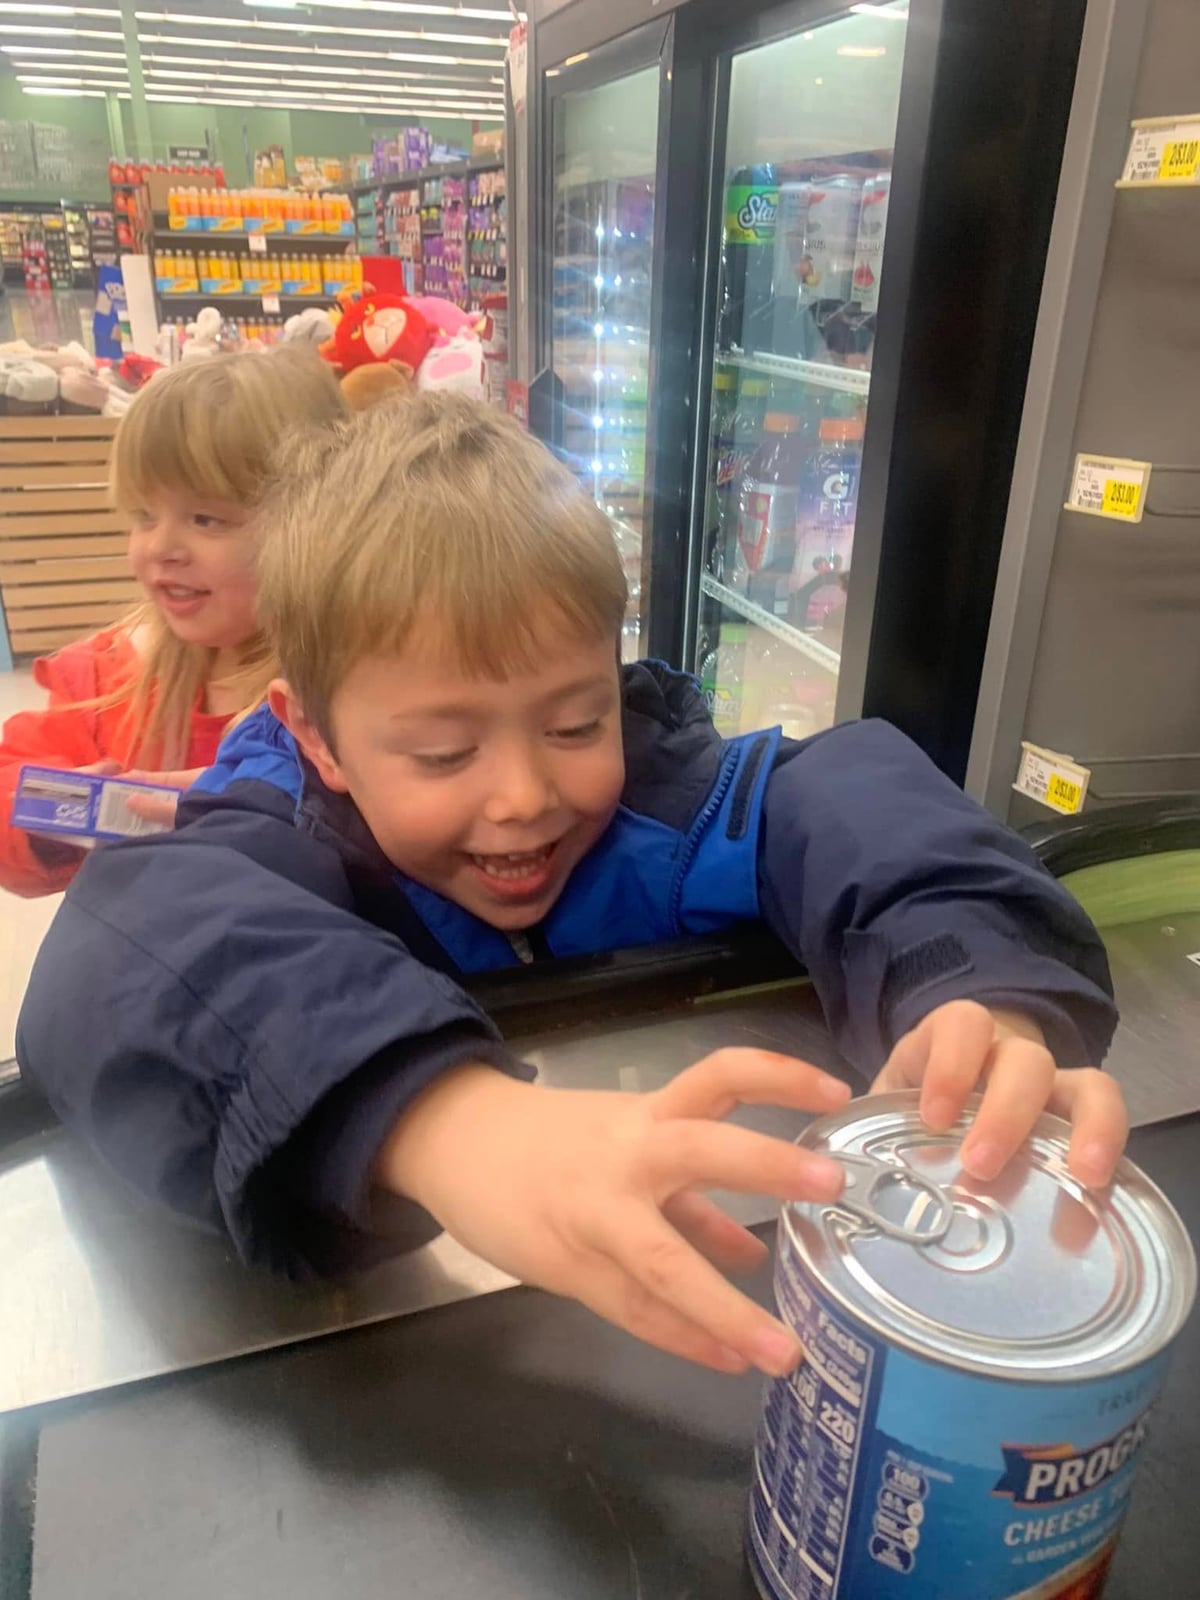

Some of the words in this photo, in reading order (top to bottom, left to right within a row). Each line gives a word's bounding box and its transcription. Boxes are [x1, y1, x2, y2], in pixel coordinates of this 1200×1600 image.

[823, 472, 850, 500] G
[820, 501, 853, 517] FIT
[820, 1400, 855, 1444] 220
[1004, 1497, 1103, 1547] CHEESE
